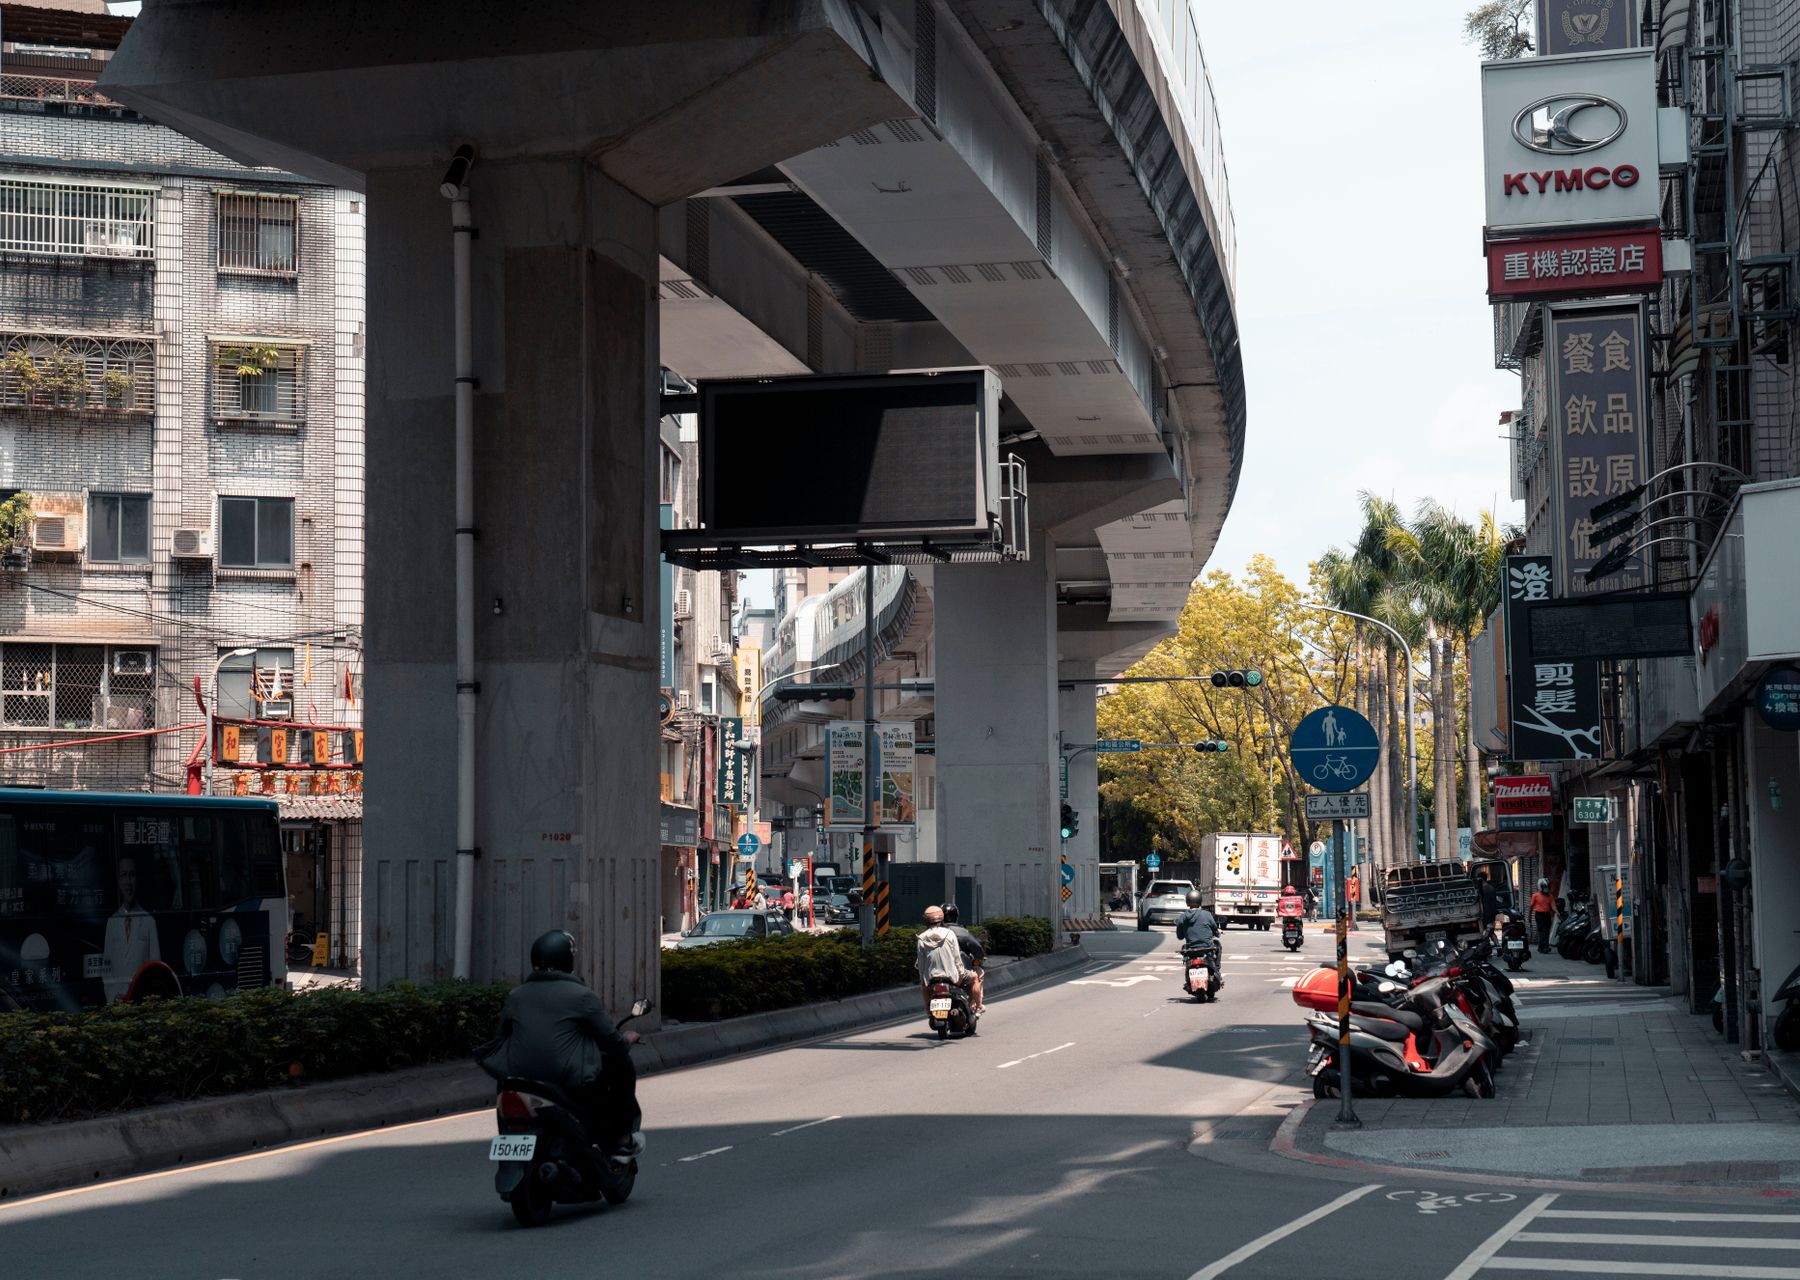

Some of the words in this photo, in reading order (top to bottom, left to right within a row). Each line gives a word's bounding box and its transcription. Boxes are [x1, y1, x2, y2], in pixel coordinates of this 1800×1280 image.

[1504, 164, 1640, 195] KYMCO
[1504, 244, 1645, 280] 重機認證店
[1509, 562, 1552, 601] 澄
[1534, 662, 1576, 714] 剪髮
[1308, 796, 1366, 808] 行人優先
[492, 1143, 534, 1157] 150-KRF
